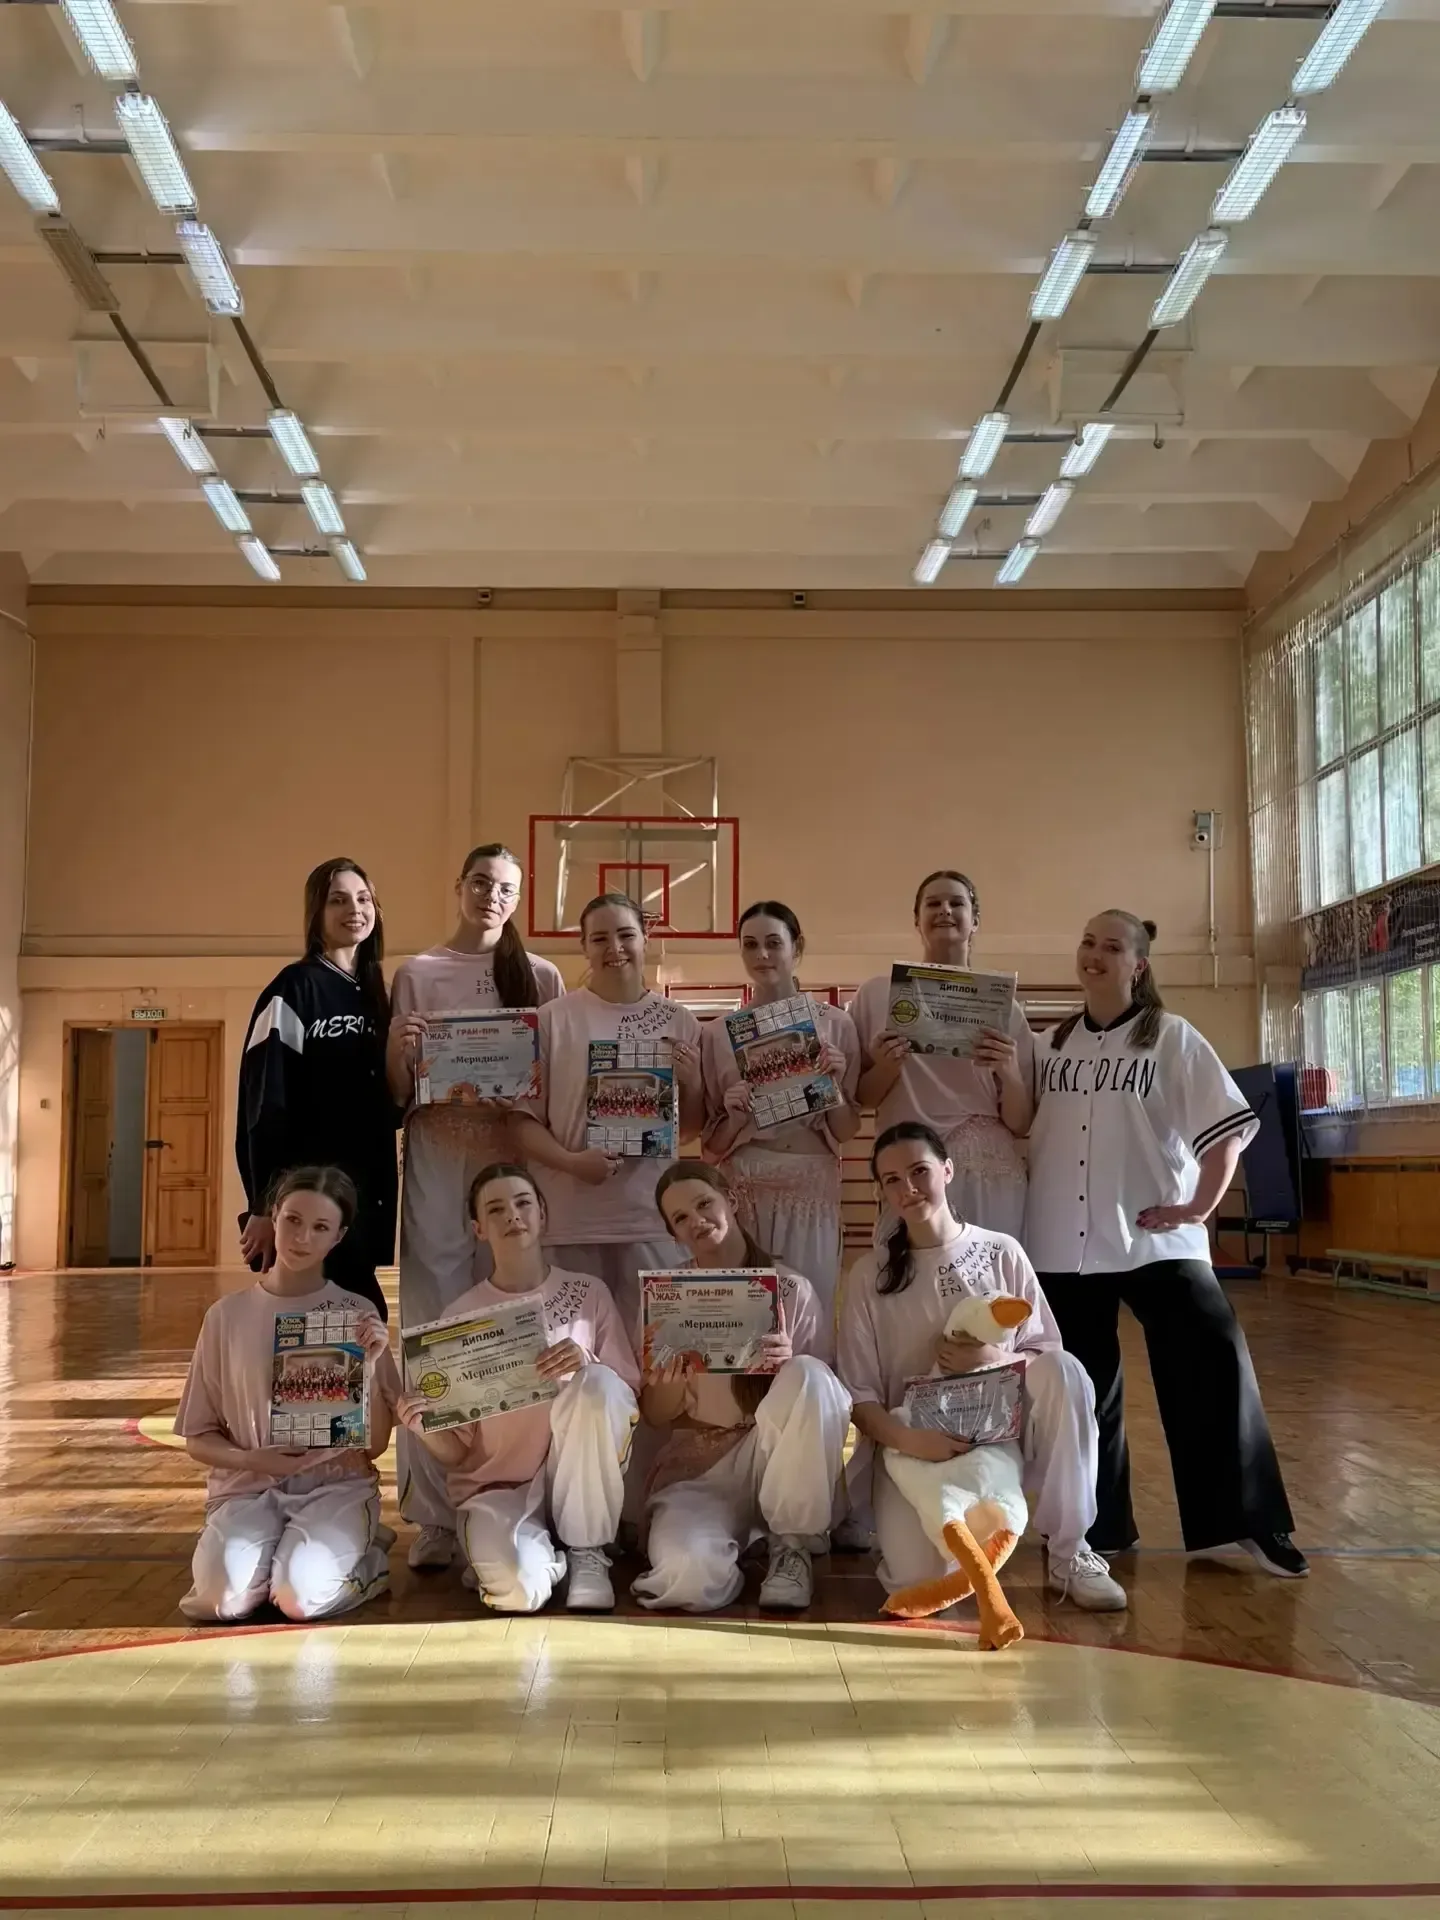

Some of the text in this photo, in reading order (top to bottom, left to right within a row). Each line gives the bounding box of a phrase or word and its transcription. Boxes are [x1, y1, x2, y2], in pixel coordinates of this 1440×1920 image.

[939, 983, 979, 994] ДИПЛОМ
[134, 1010, 163, 1019] ВЫХОД
[621, 1001, 661, 1023] MILANA
[637, 1004, 669, 1029] ALWAYS
[642, 1007, 678, 1036] DANCE
[456, 1028, 500, 1036] ГРАН-ПРИ
[450, 1055, 510, 1065] «Меридиан»
[938, 1241, 980, 1275] DASHKA
[940, 1240, 991, 1287] IS ALWAYS
[941, 1242, 1002, 1298] IN DANCE
[544, 1281, 570, 1311] SHULYA
[553, 1280, 581, 1318] ALWAYS
[559, 1280, 590, 1325] DANCE
[686, 1288, 734, 1297] ГРАН-ПРИ
[679, 1319, 744, 1330] «Меридиан»
[461, 1328, 506, 1348] ДИПЛОМ
[456, 1358, 525, 1384] «Меридиан»
